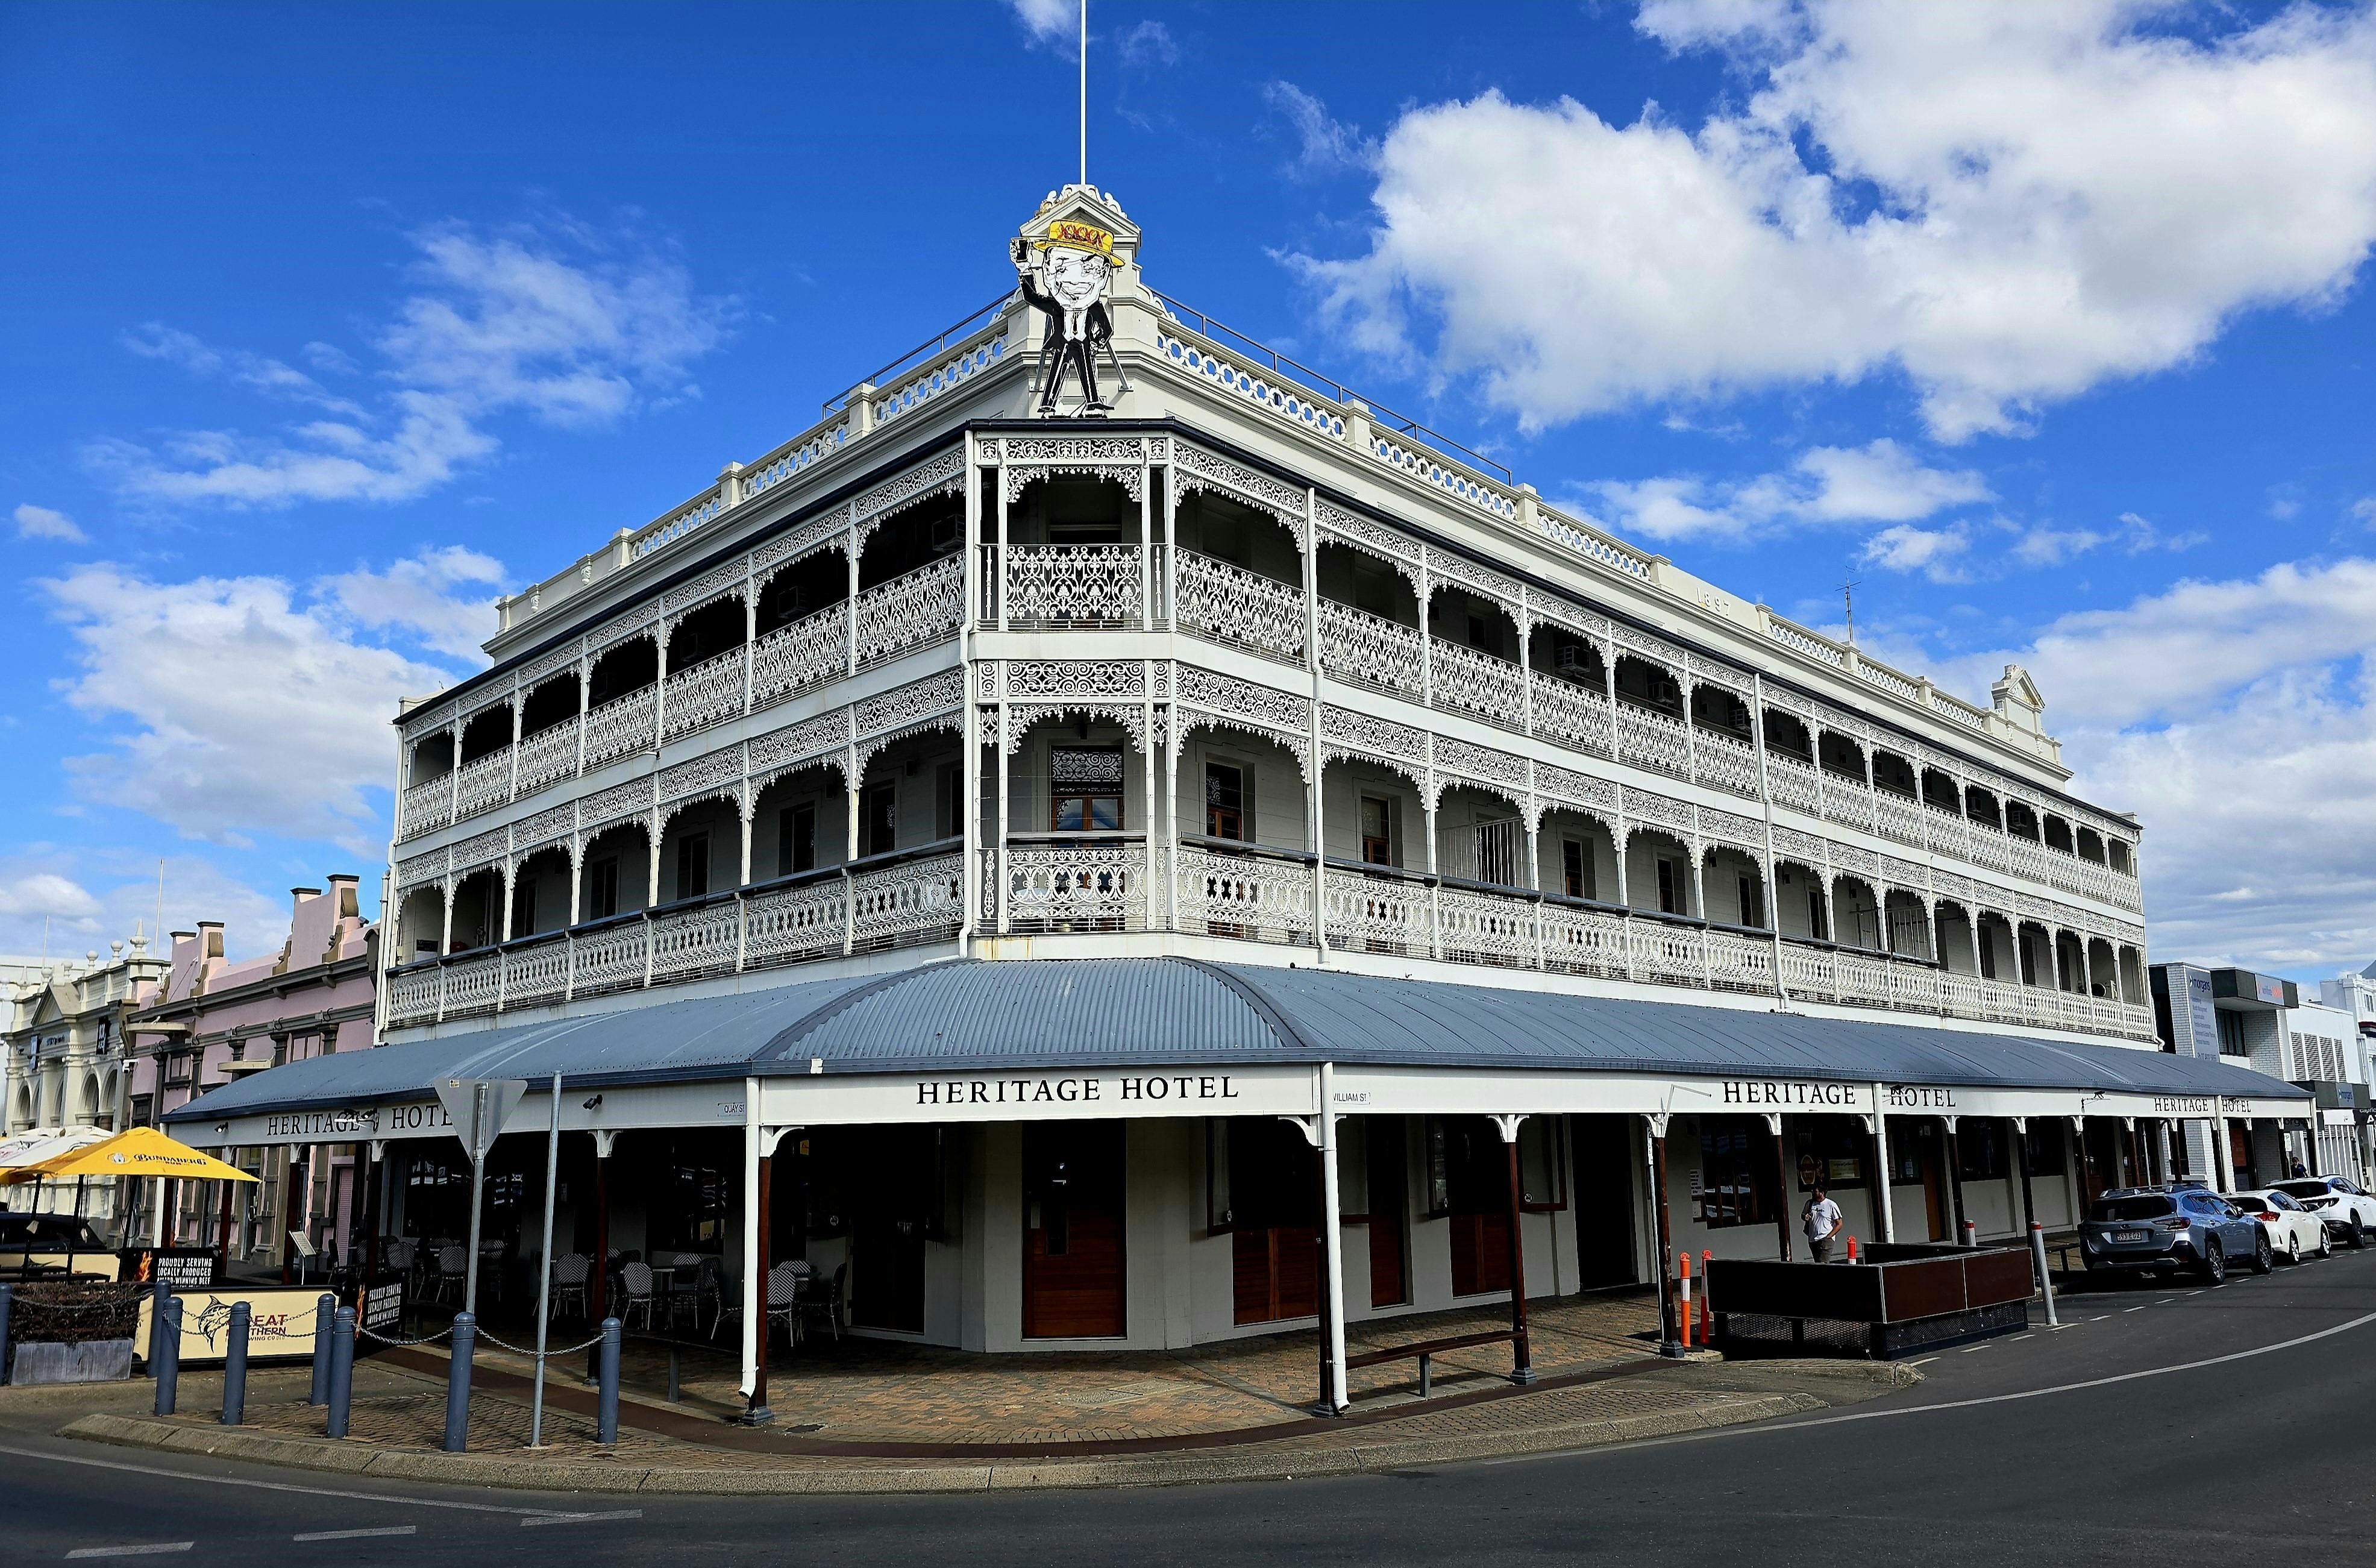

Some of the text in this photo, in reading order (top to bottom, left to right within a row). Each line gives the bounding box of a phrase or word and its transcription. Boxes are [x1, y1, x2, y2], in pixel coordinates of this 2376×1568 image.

[1057, 221, 1106, 248] XXXX
[1696, 587, 1731, 616] 1897
[917, 1076, 1239, 1104] HERITAGE HOTEL
[1722, 1081, 1956, 1108] HERITAGE HOTEL
[724, 1105, 738, 1113] QUAY
[2154, 1097, 2251, 1112] HERITAGE HOTEL
[267, 1104, 453, 1136] HERITAGE HOTE
[157, 1267, 211, 1276] LOCALLY PRODUCED
[158, 1258, 212, 1267] PROUDLY SERVING
[368, 1282, 401, 1302] PROUDLY SERVING
[368, 1295, 401, 1314] LOCALLY PRODUCED
[254, 1314, 288, 1326] EAT
